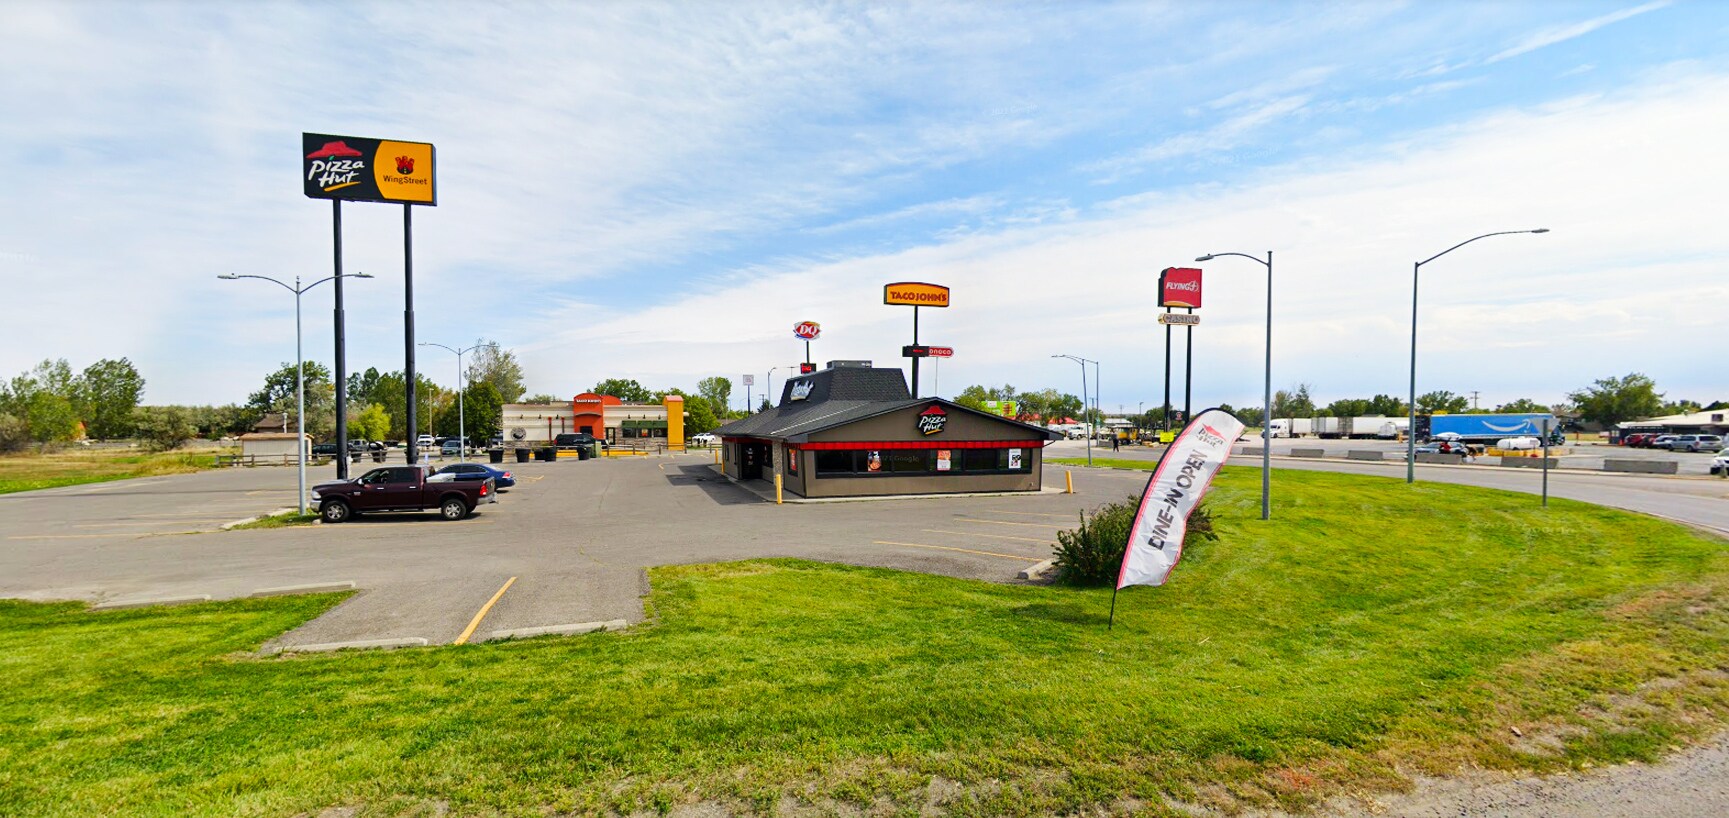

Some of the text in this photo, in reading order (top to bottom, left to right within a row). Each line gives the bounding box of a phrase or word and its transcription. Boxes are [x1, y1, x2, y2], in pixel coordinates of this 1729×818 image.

[307, 156, 365, 181] Pizza
[318, 170, 360, 188] Hut
[383, 175, 427, 185] WingStreet
[1166, 282, 1189, 290] FLYING
[799, 324, 818, 336] DQ
[928, 348, 952, 356] onoco
[919, 414, 947, 428] Pizza
[923, 422, 943, 432] Hut
[1148, 448, 1208, 551] DINE-IN OPEN
